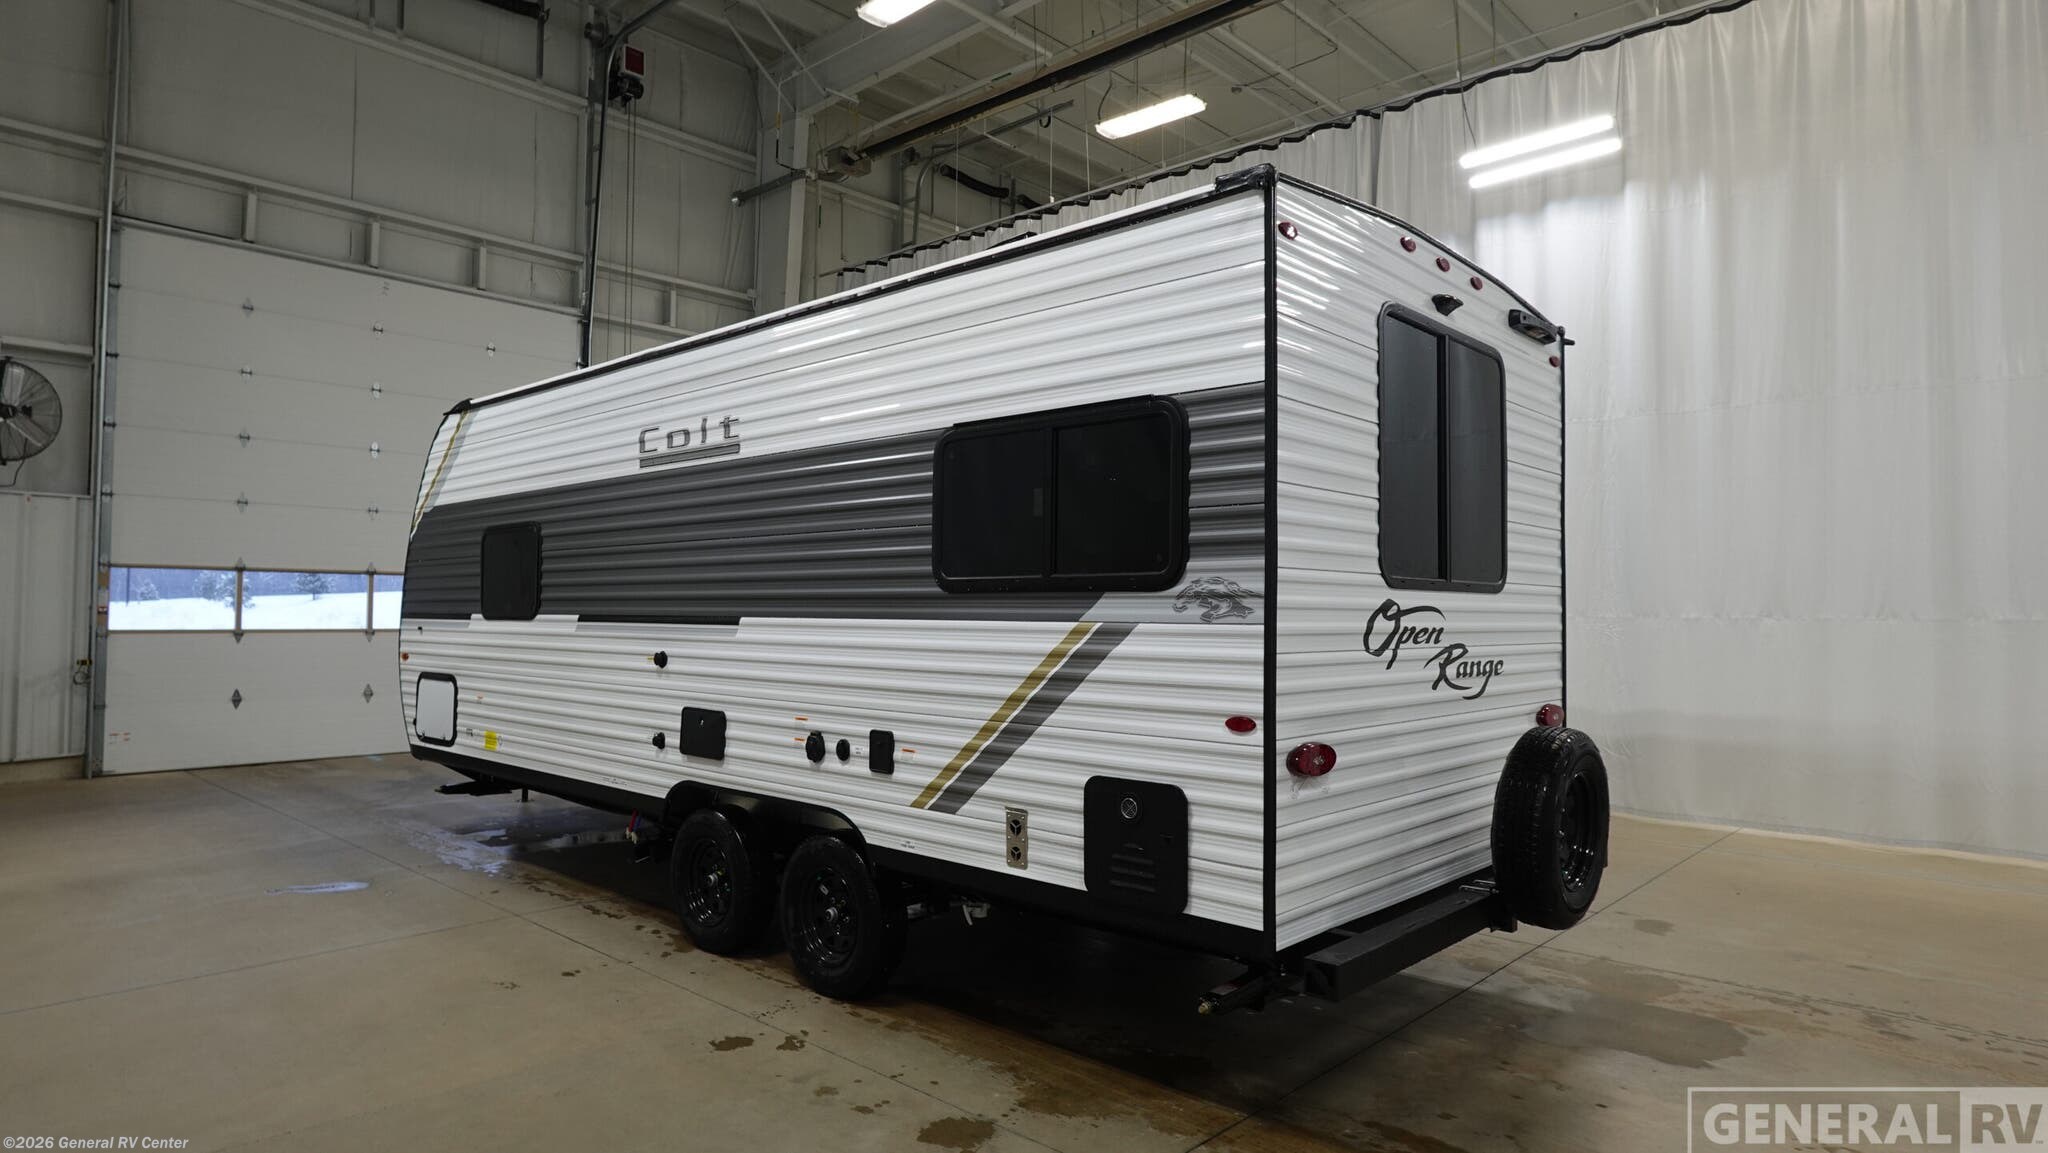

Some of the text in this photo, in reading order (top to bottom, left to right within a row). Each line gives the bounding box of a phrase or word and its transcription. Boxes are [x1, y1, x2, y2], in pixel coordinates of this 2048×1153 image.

[638, 415, 740, 454] Colt
[1363, 598, 1446, 670] Open
[1423, 643, 1505, 700] Range
